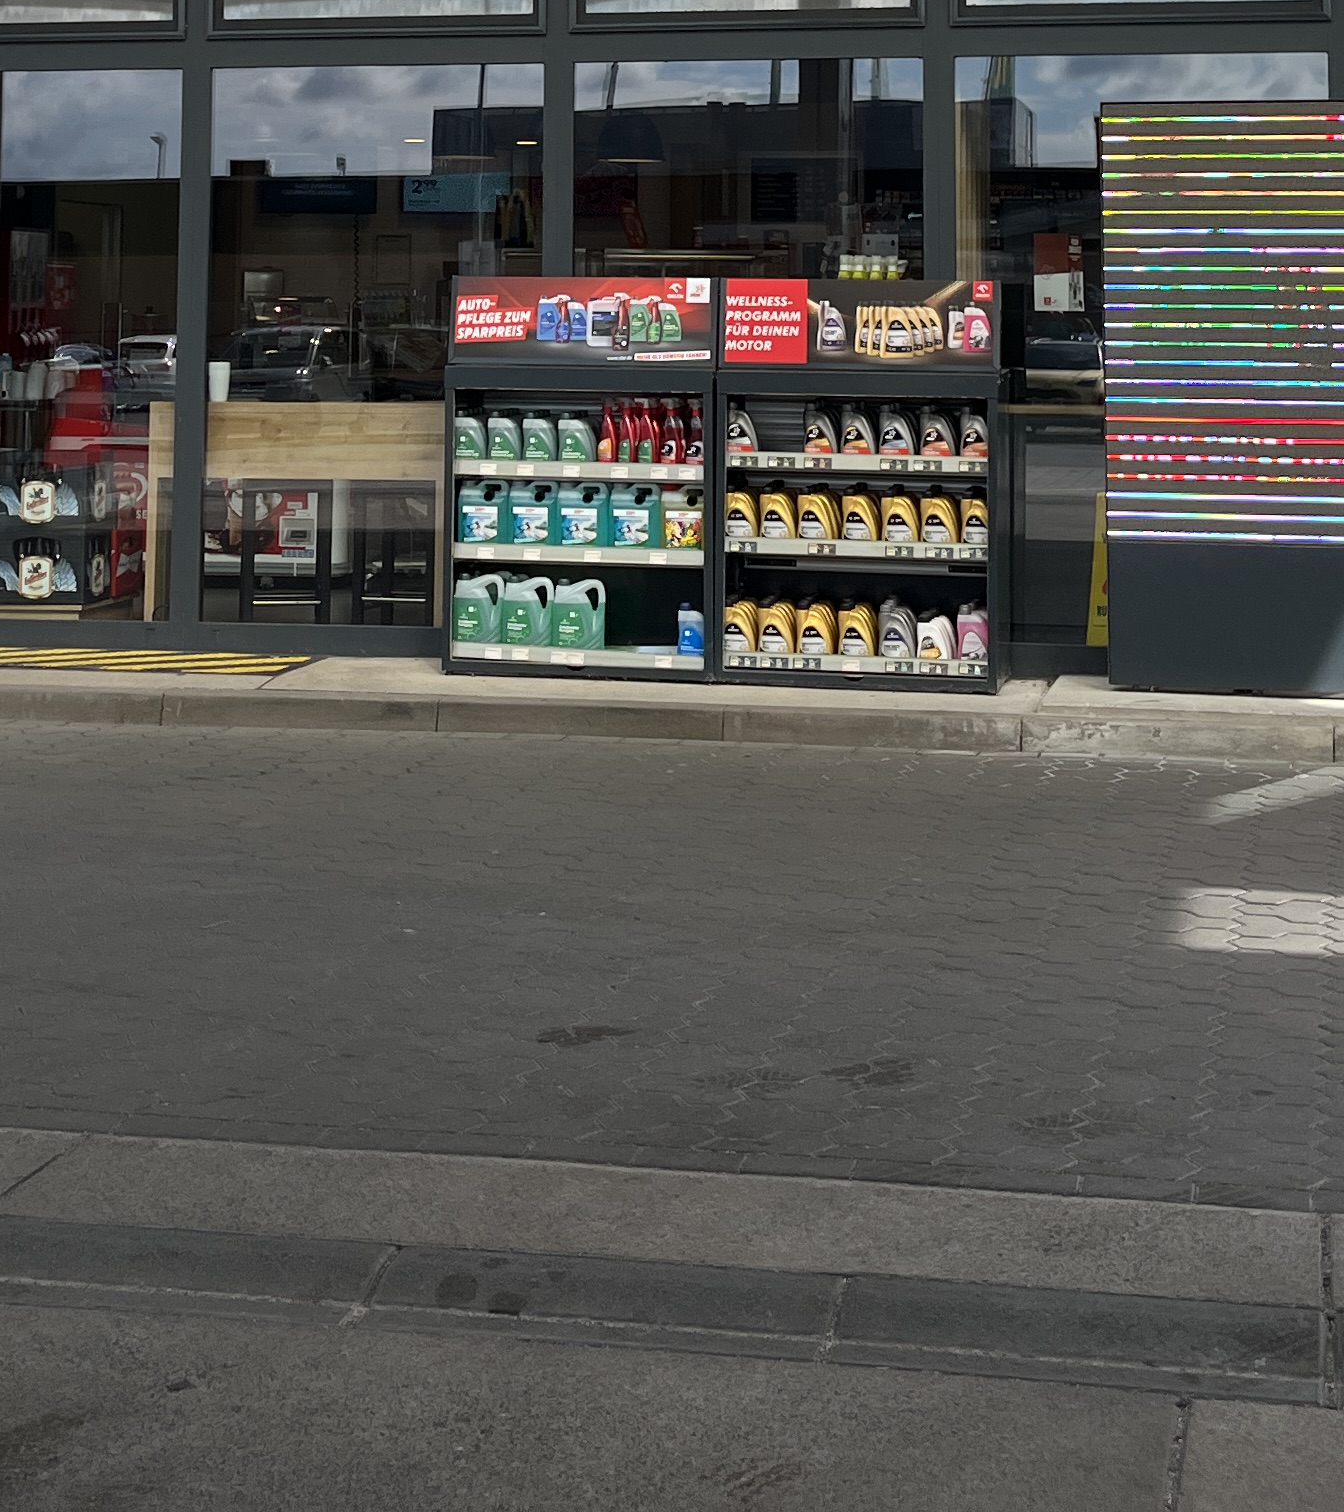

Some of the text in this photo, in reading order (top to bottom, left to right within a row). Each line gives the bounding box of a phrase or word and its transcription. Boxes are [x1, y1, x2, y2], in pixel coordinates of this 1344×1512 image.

[457, 299, 496, 312] AUTO-
[725, 295, 794, 307] WELLNESS-
[457, 310, 531, 325] PFLEGE ZUM
[725, 310, 801, 322] PROGRAMM
[456, 324, 525, 340] SPARPREIS
[724, 323, 800, 337] FÜR DEINEN
[724, 339, 772, 351] MOTOR
